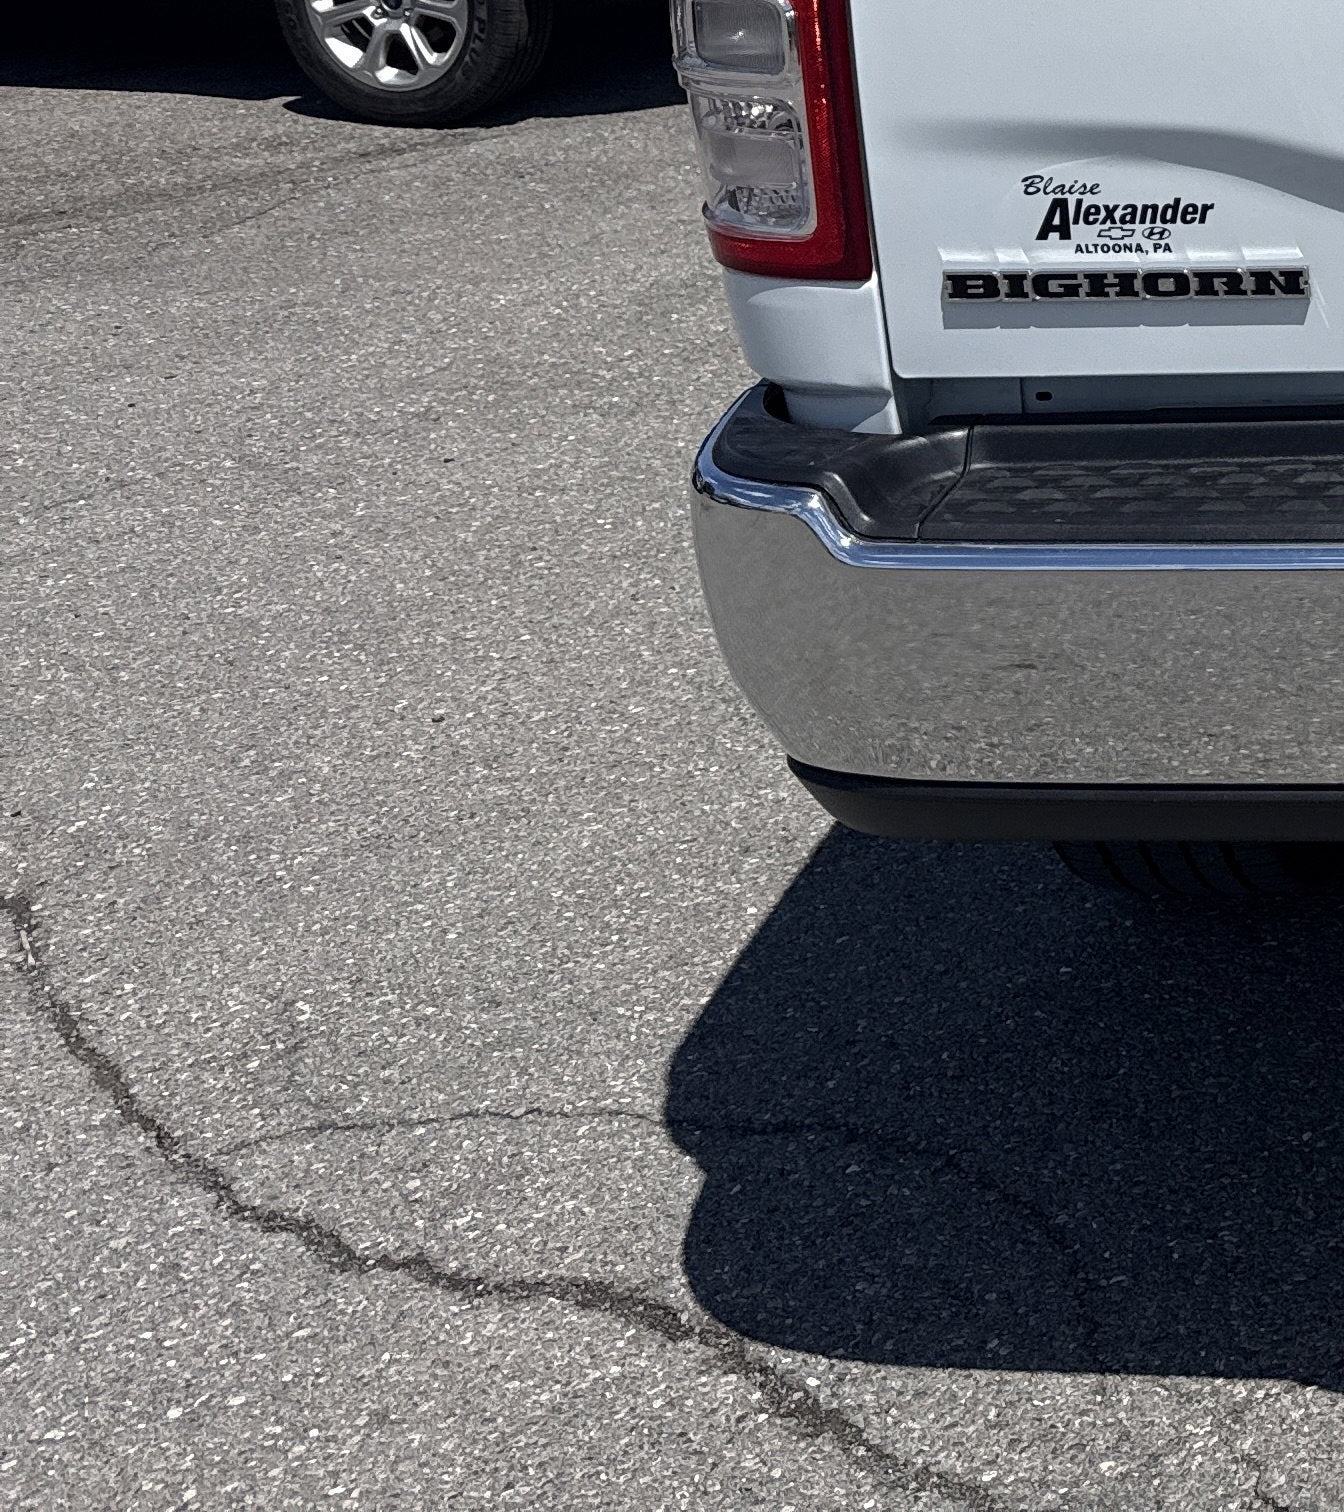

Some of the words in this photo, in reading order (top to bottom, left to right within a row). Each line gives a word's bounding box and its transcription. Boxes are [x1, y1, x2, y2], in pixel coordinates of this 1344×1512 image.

[1021, 175, 1101, 196] Blaise
[1035, 197, 1215, 240] Alexander
[1074, 243, 1149, 255] ALTOONA,
[1153, 243, 1173, 253] PA
[943, 266, 1311, 303] BIGHORN
